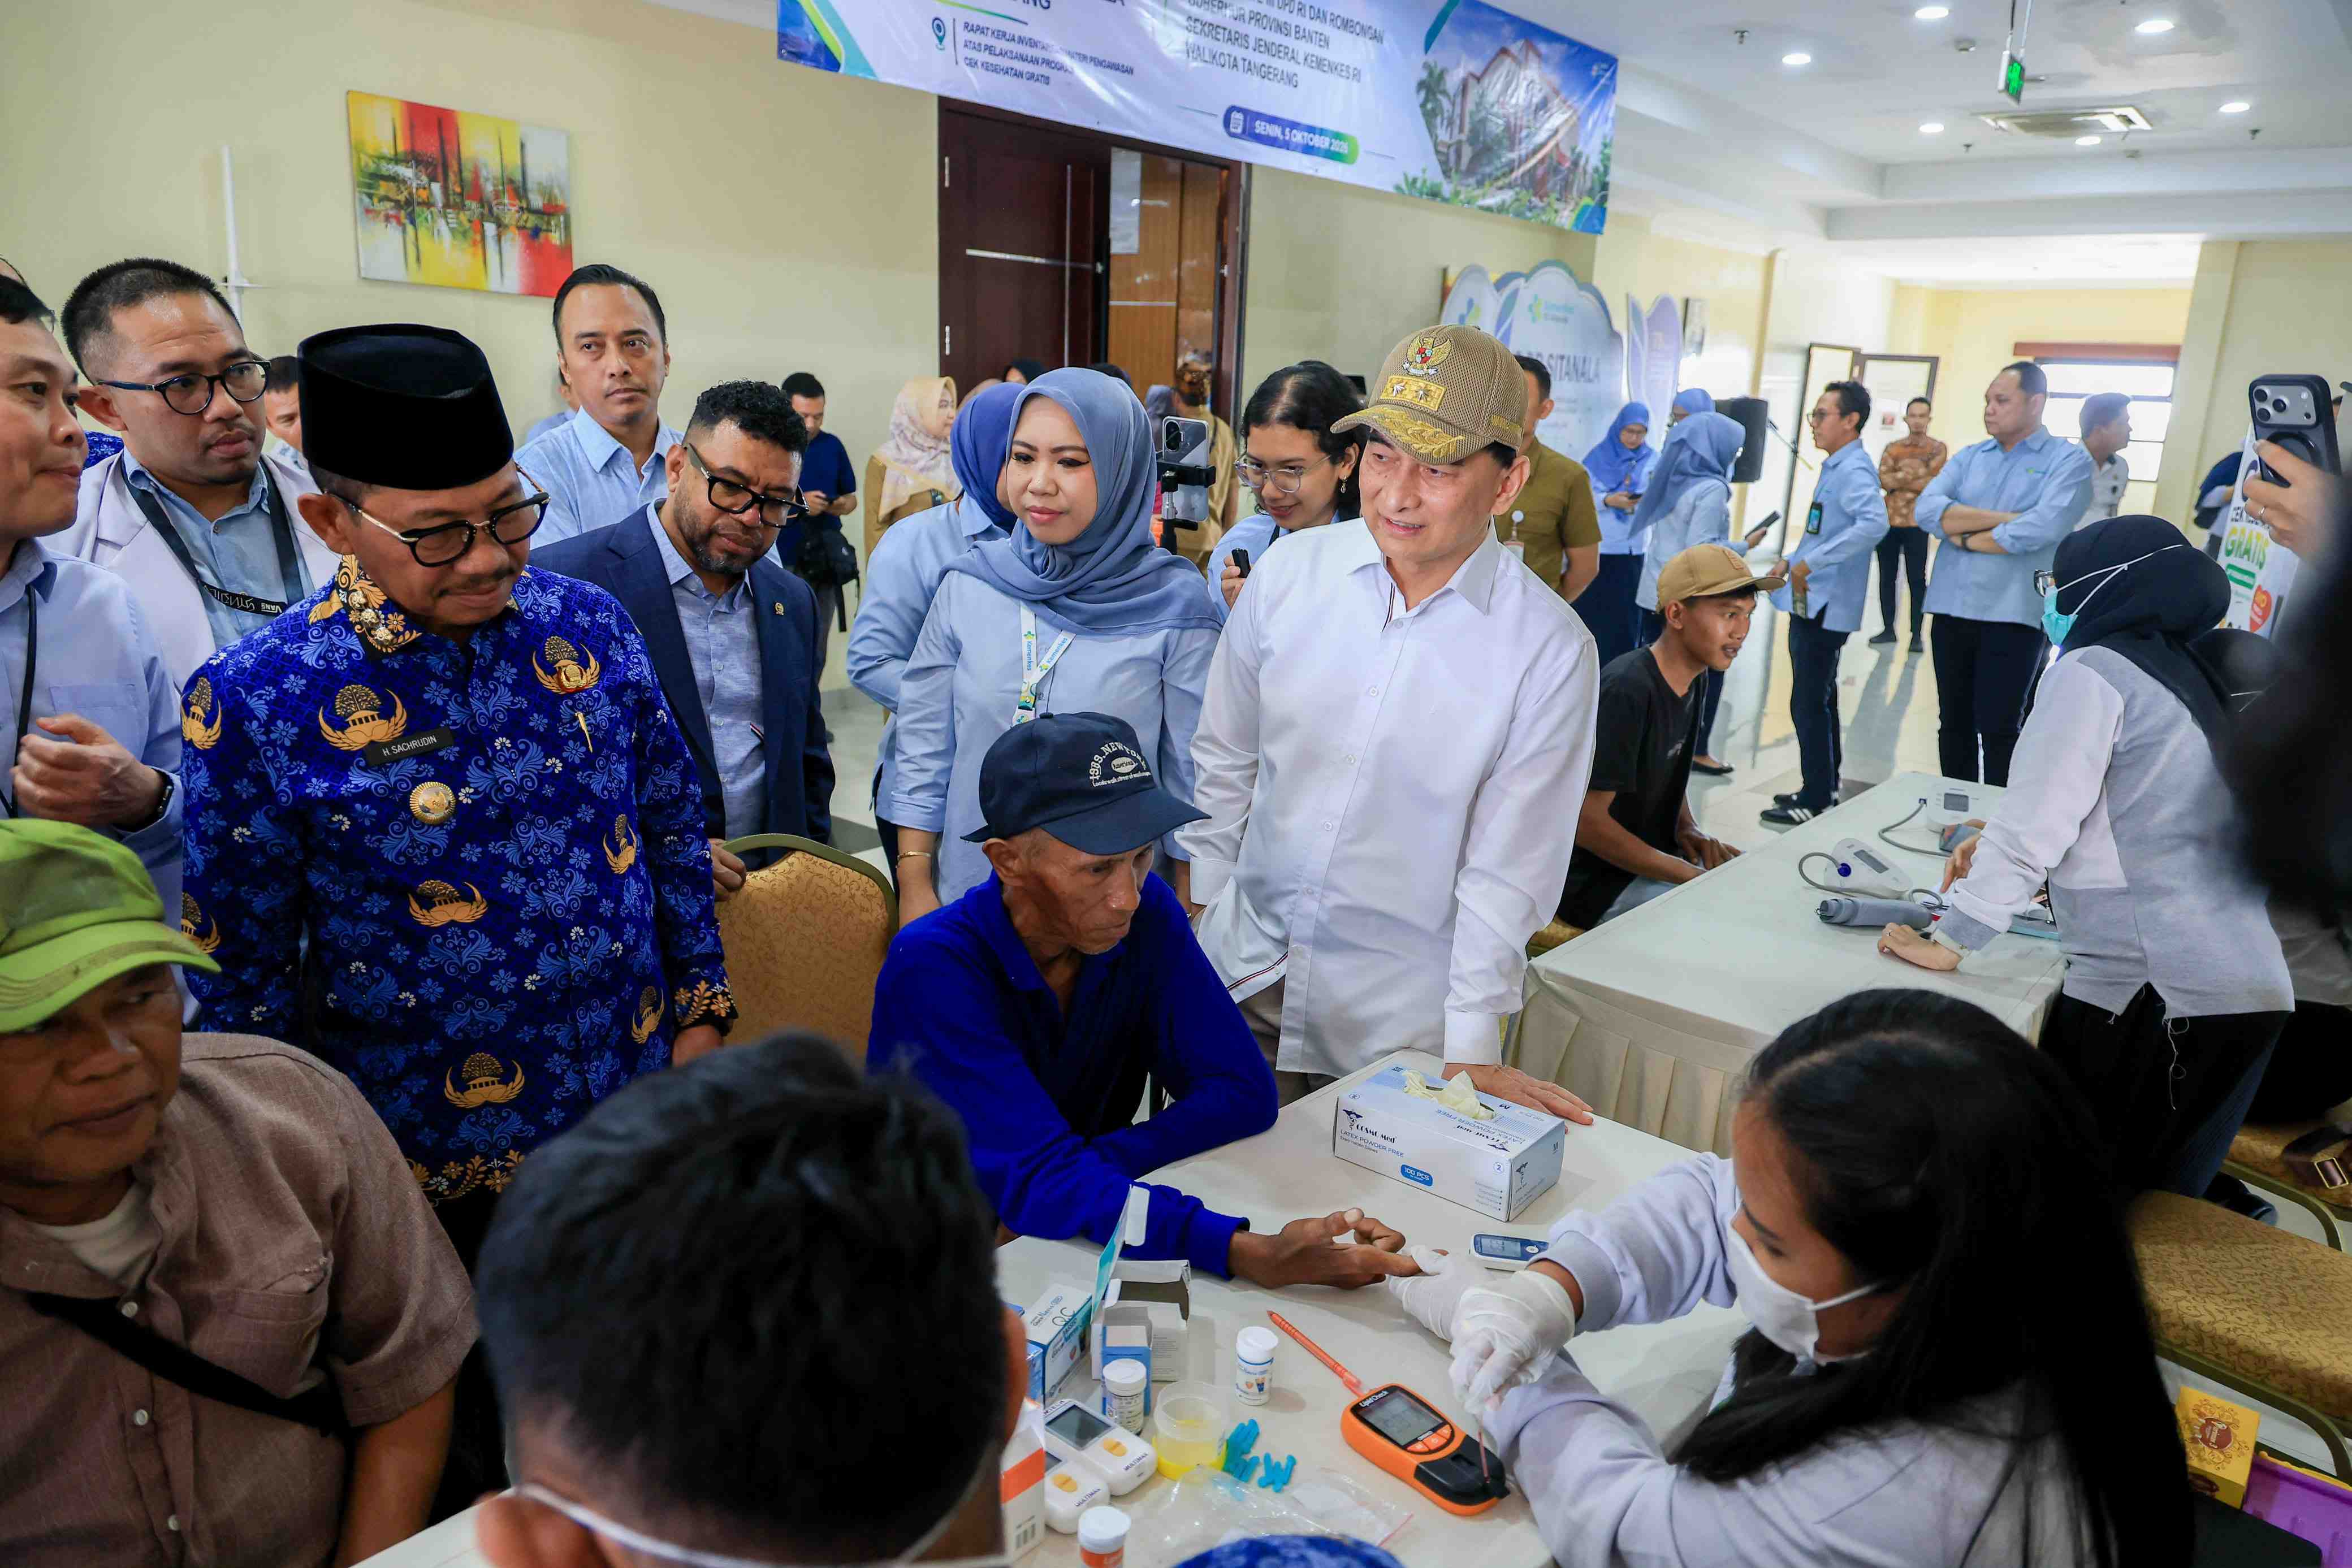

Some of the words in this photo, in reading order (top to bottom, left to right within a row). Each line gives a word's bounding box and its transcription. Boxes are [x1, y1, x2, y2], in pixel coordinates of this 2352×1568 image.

[1248, 10, 1292, 37] PROVINSI
[1294, 24, 1329, 49] BANTEN
[1297, 2, 1306, 18] RI
[1309, 5, 1328, 24] DAN
[1329, 12, 1384, 45] ROMBONGAN
[963, 21, 989, 36] RAPAT
[991, 29, 1016, 42] KERJA
[1089, 55, 1134, 75] PENGAWASAN
[963, 40, 982, 52] ATAS
[983, 44, 1040, 66] PELAKSANAAN
[1186, 16, 1250, 49] SEKRETARIS
[1252, 36, 1301, 65] JENDERAL
[1303, 52, 1351, 79] KEMENKES
[1352, 67, 1361, 83] RI
[963, 57, 978, 68] CEK
[980, 60, 1023, 79] KESEHATAN
[1025, 71, 1050, 85] GRATIS
[1241, 57, 1298, 88] TANGERANG
[261, 601, 282, 614] VANS
[382, 747, 391, 756] H.
[391, 735, 437, 754] SACHRUDIN
[1340, 1129, 1358, 1140] LATEX
[1359, 1136, 1386, 1150] POWDER
[1388, 1148, 1404, 1158] FREE
[1404, 1166, 1415, 1176] 100
[1416, 1171, 1430, 1181] PCS
